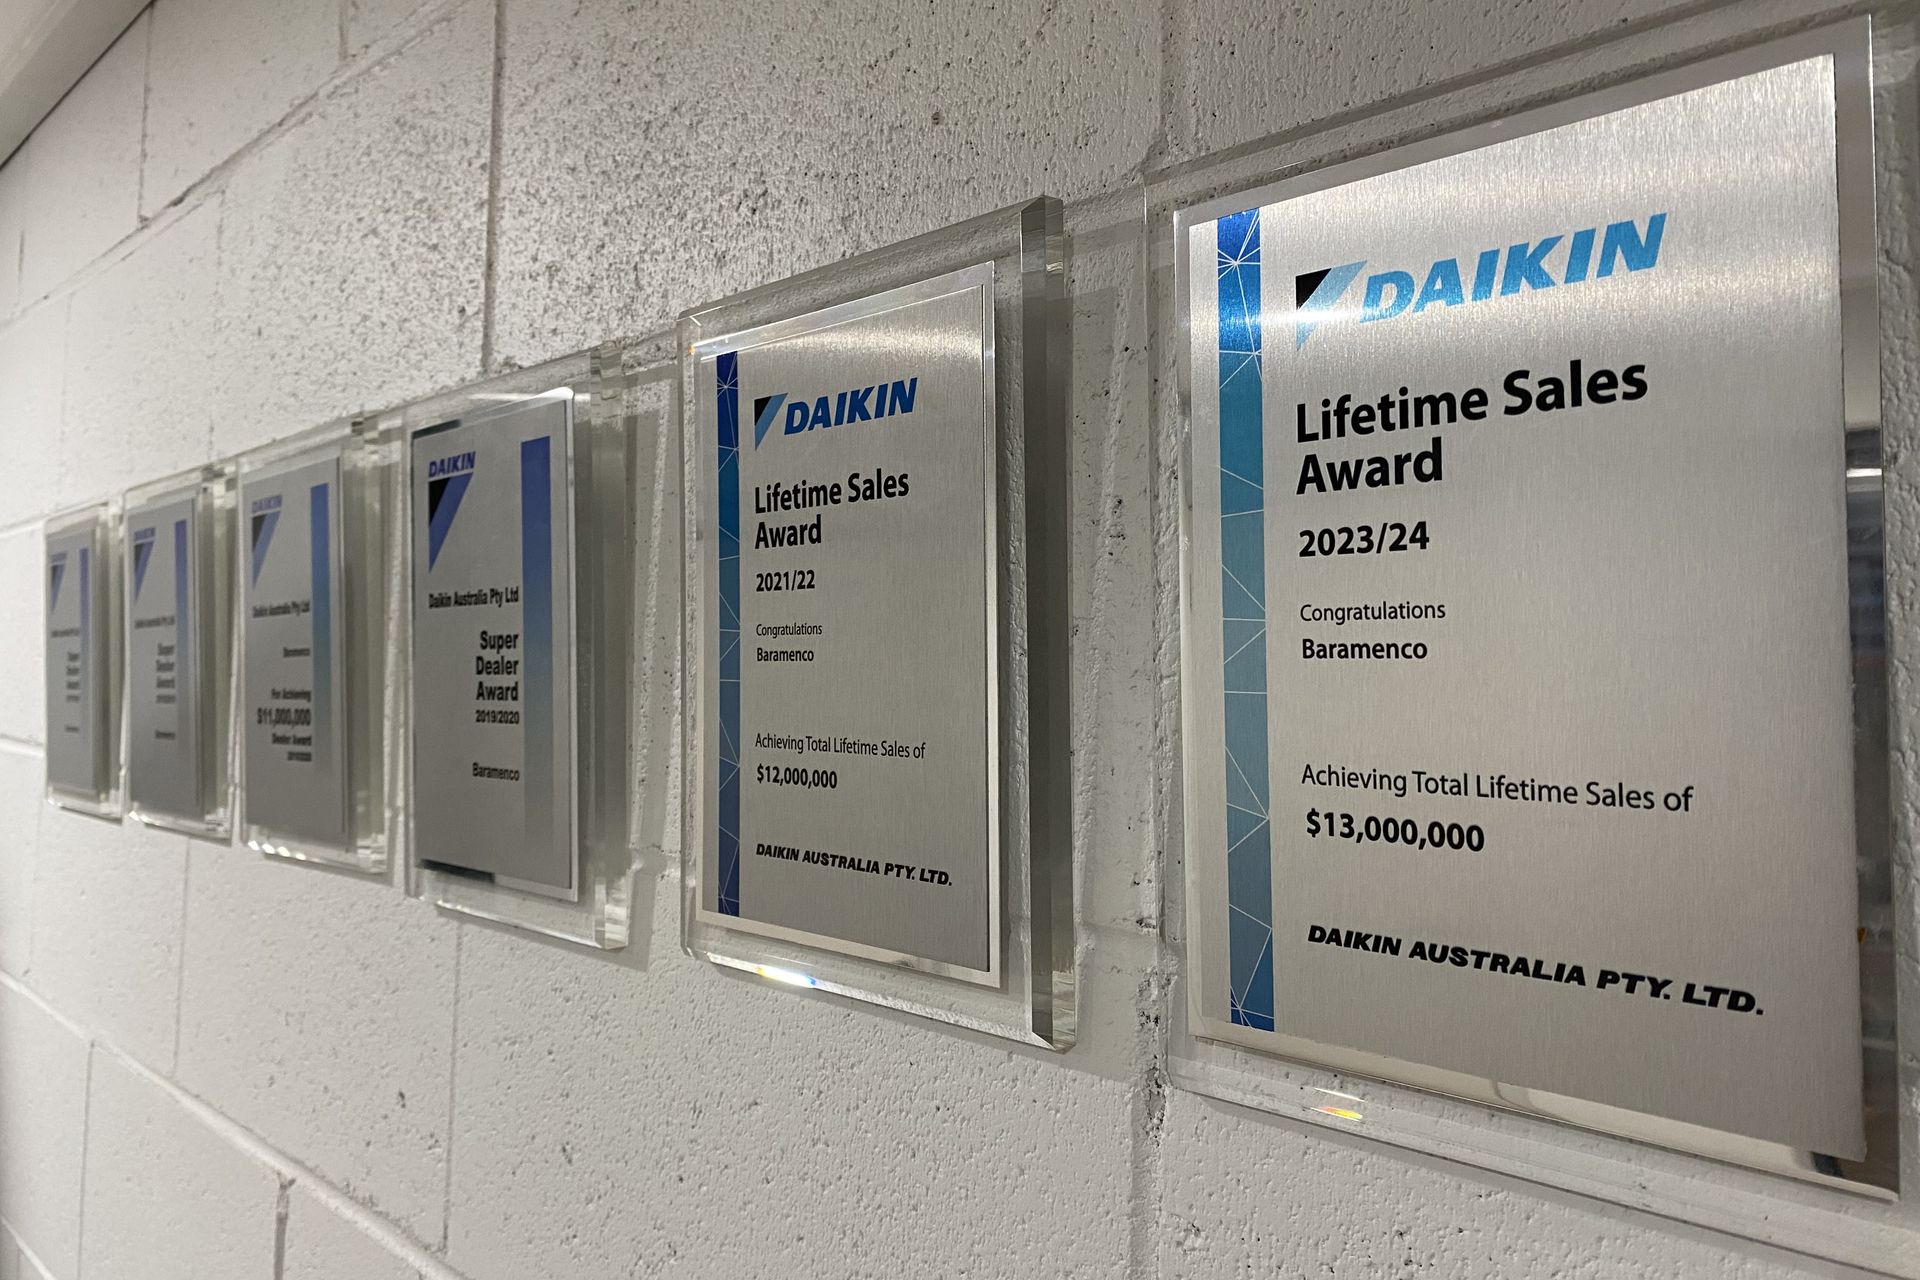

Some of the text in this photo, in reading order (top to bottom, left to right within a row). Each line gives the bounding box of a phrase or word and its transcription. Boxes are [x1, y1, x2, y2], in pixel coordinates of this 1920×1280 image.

[1358, 212, 1668, 324] DAIKIN
[783, 376, 918, 436] DAIKIN
[1296, 358, 1649, 444] Lifetime Sales
[428, 451, 476, 478] DAIKIN
[1295, 436, 1444, 496] Award
[754, 467, 910, 515] Lifetime Sales
[754, 513, 823, 550] Award
[1298, 520, 1431, 558] 2023/24
[755, 569, 816, 593] 2021/22
[429, 586, 519, 609] Daikin Australia Pty Ltd
[1299, 600, 1447, 626] Congratulations
[479, 630, 519, 654] Super
[755, 622, 824, 639] Congratulations
[756, 647, 815, 662] Baramenco
[1300, 637, 1429, 661] Baramenco
[475, 655, 519, 676] Dealer
[475, 681, 519, 701] Award
[475, 709, 520, 725] 2019/2020
[755, 733, 926, 759] Achieving Total Lifetime Sales of
[472, 762, 520, 781] Baramenco
[756, 764, 838, 789] $12,000,000
[1300, 763, 1695, 813] Achieving Total Lifetime Sales of
[1305, 806, 1485, 853] $13,000,000
[756, 843, 952, 887] DAIKIN AUSTRALIA PTY. LTD.
[1306, 924, 1766, 1017] DAIKIN AUSTRALIA PTY. LTD.
